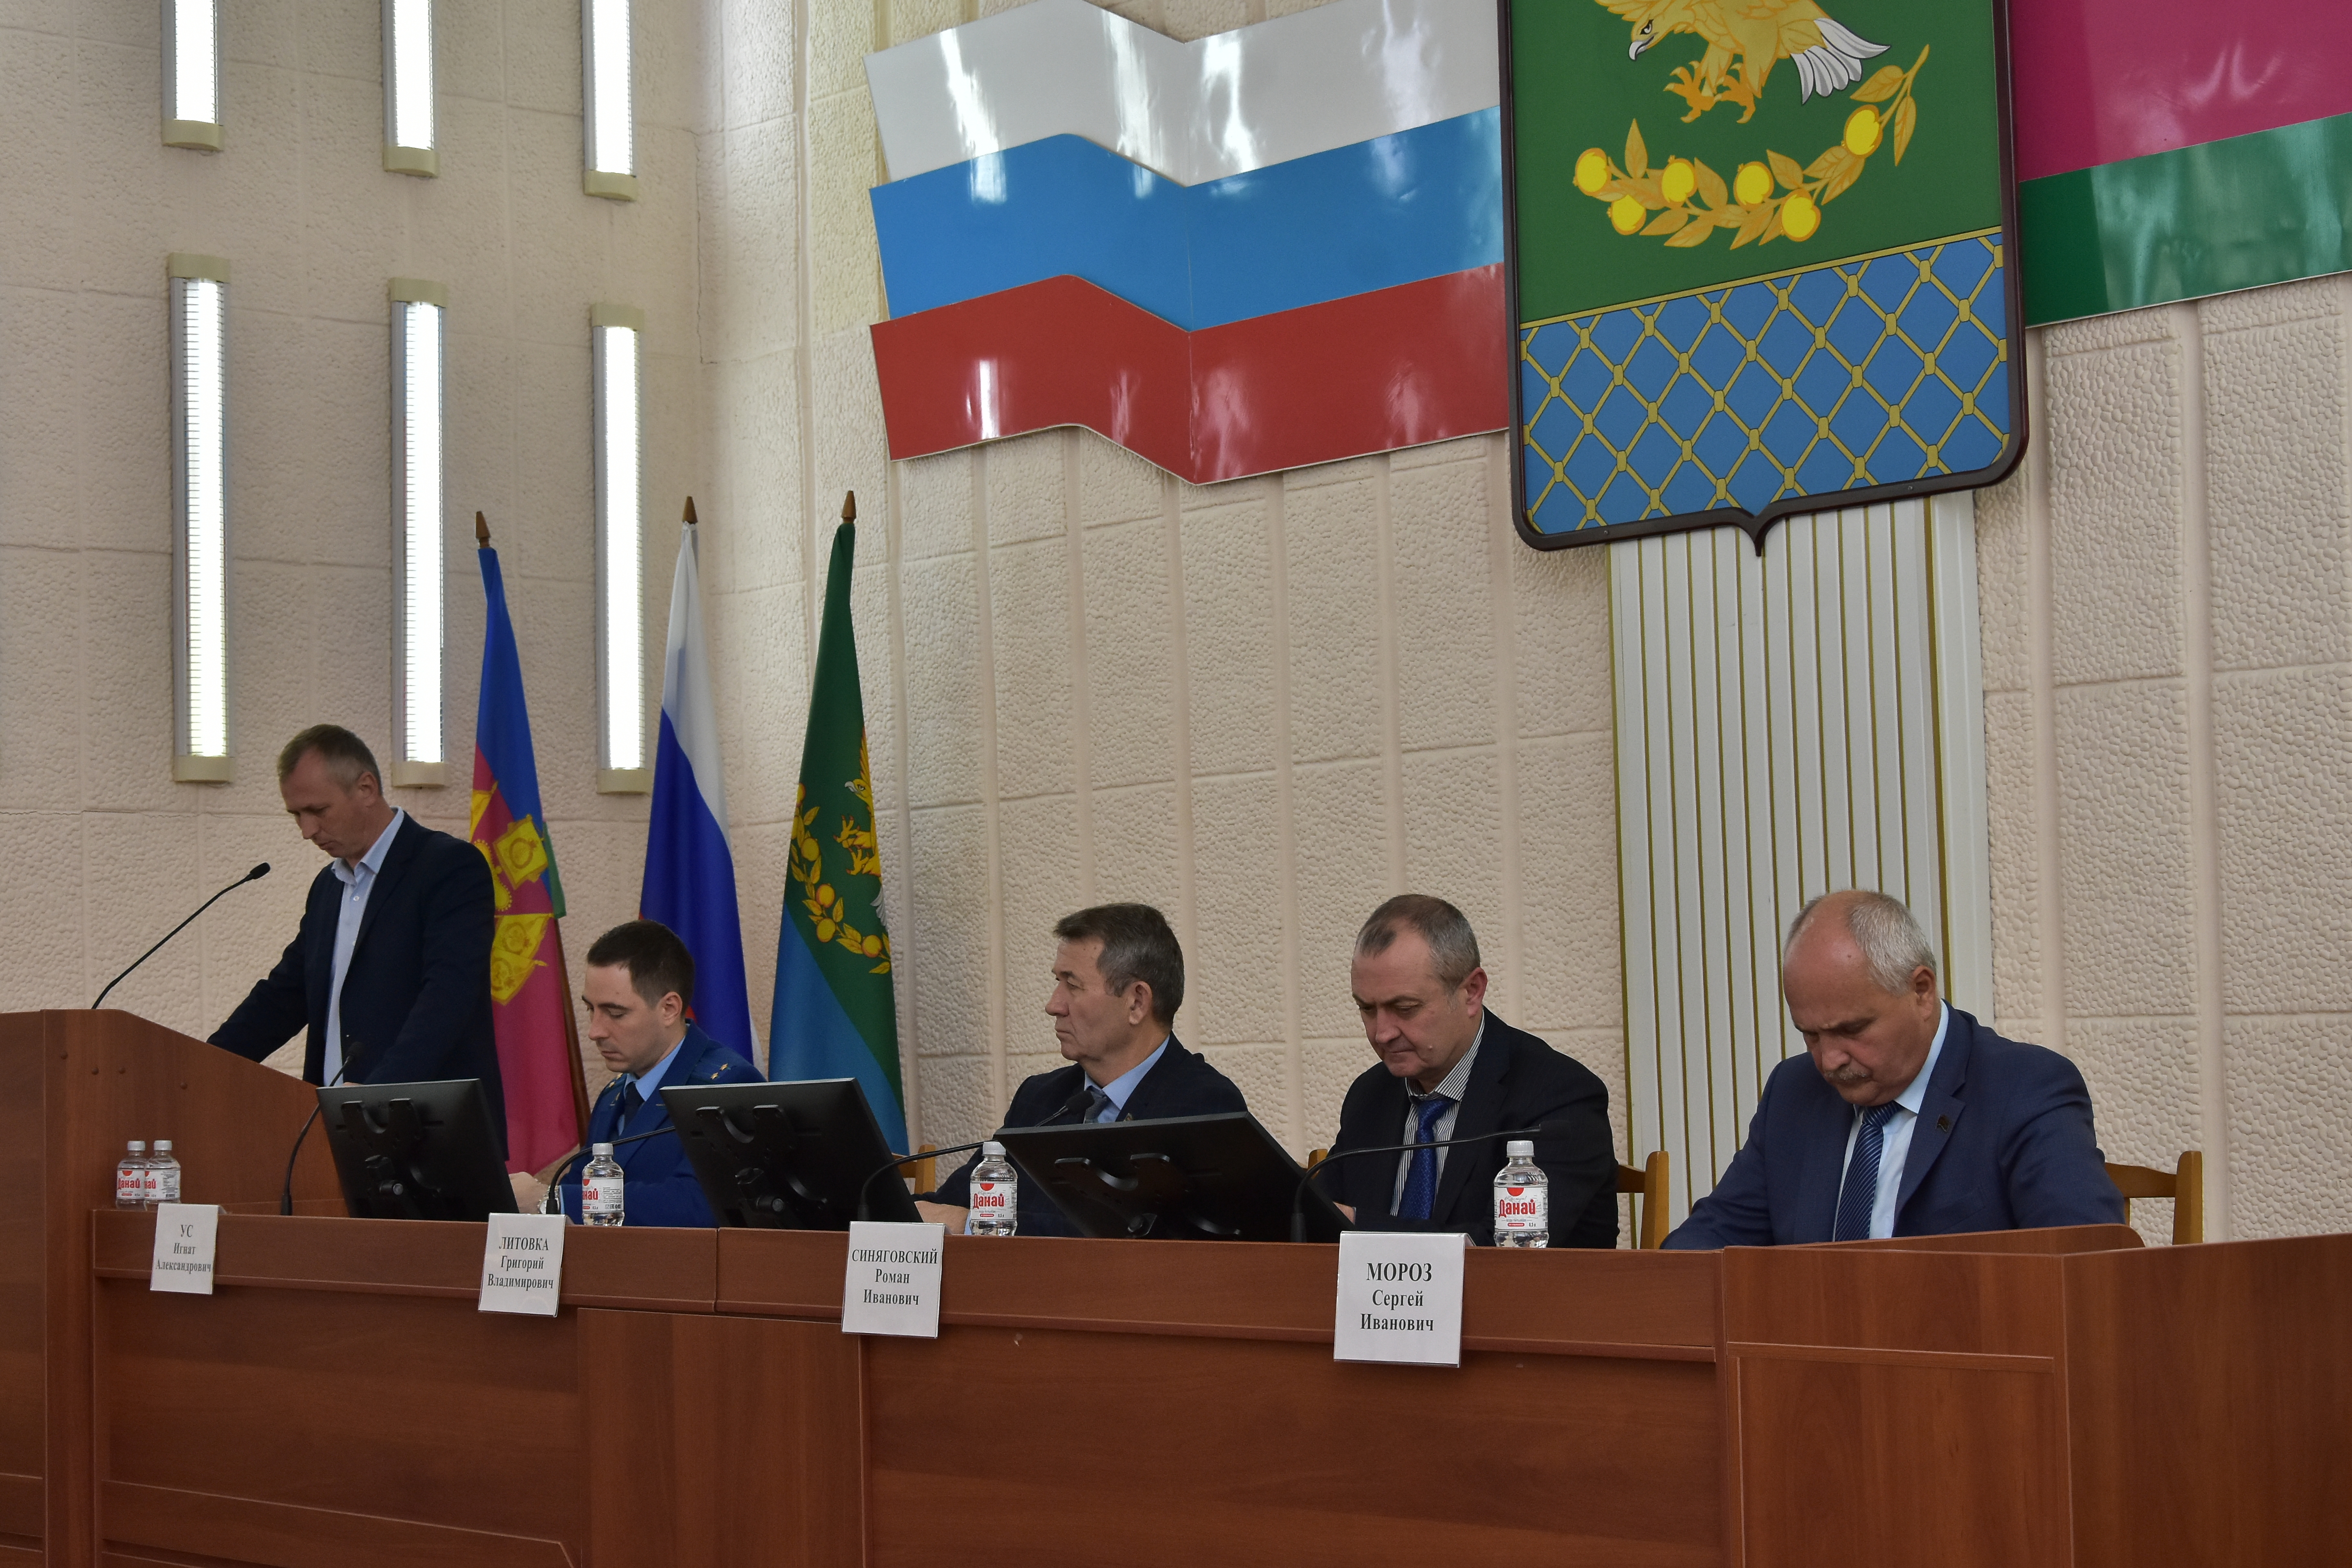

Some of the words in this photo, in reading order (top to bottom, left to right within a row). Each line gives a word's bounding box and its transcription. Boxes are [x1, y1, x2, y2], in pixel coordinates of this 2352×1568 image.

[972, 1193, 1005, 1210] Данай
[1498, 1199, 1536, 1218] Данай
[181, 1224, 193, 1238] УС
[173, 1243, 196, 1254] Игнат
[498, 1237, 549, 1251] ЛИТОВКА
[500, 1255, 544, 1272] Григорий
[852, 1248, 938, 1264] СИНЯГОВСКИЙ
[155, 1259, 211, 1274] Александрович
[1366, 1262, 1432, 1282] МОРОЗ
[487, 1273, 554, 1291] Владимирович
[875, 1268, 910, 1284] Роман
[863, 1289, 919, 1305] Иванович
[1372, 1289, 1424, 1311] Сергей
[1360, 1313, 1434, 1331] Иванович
